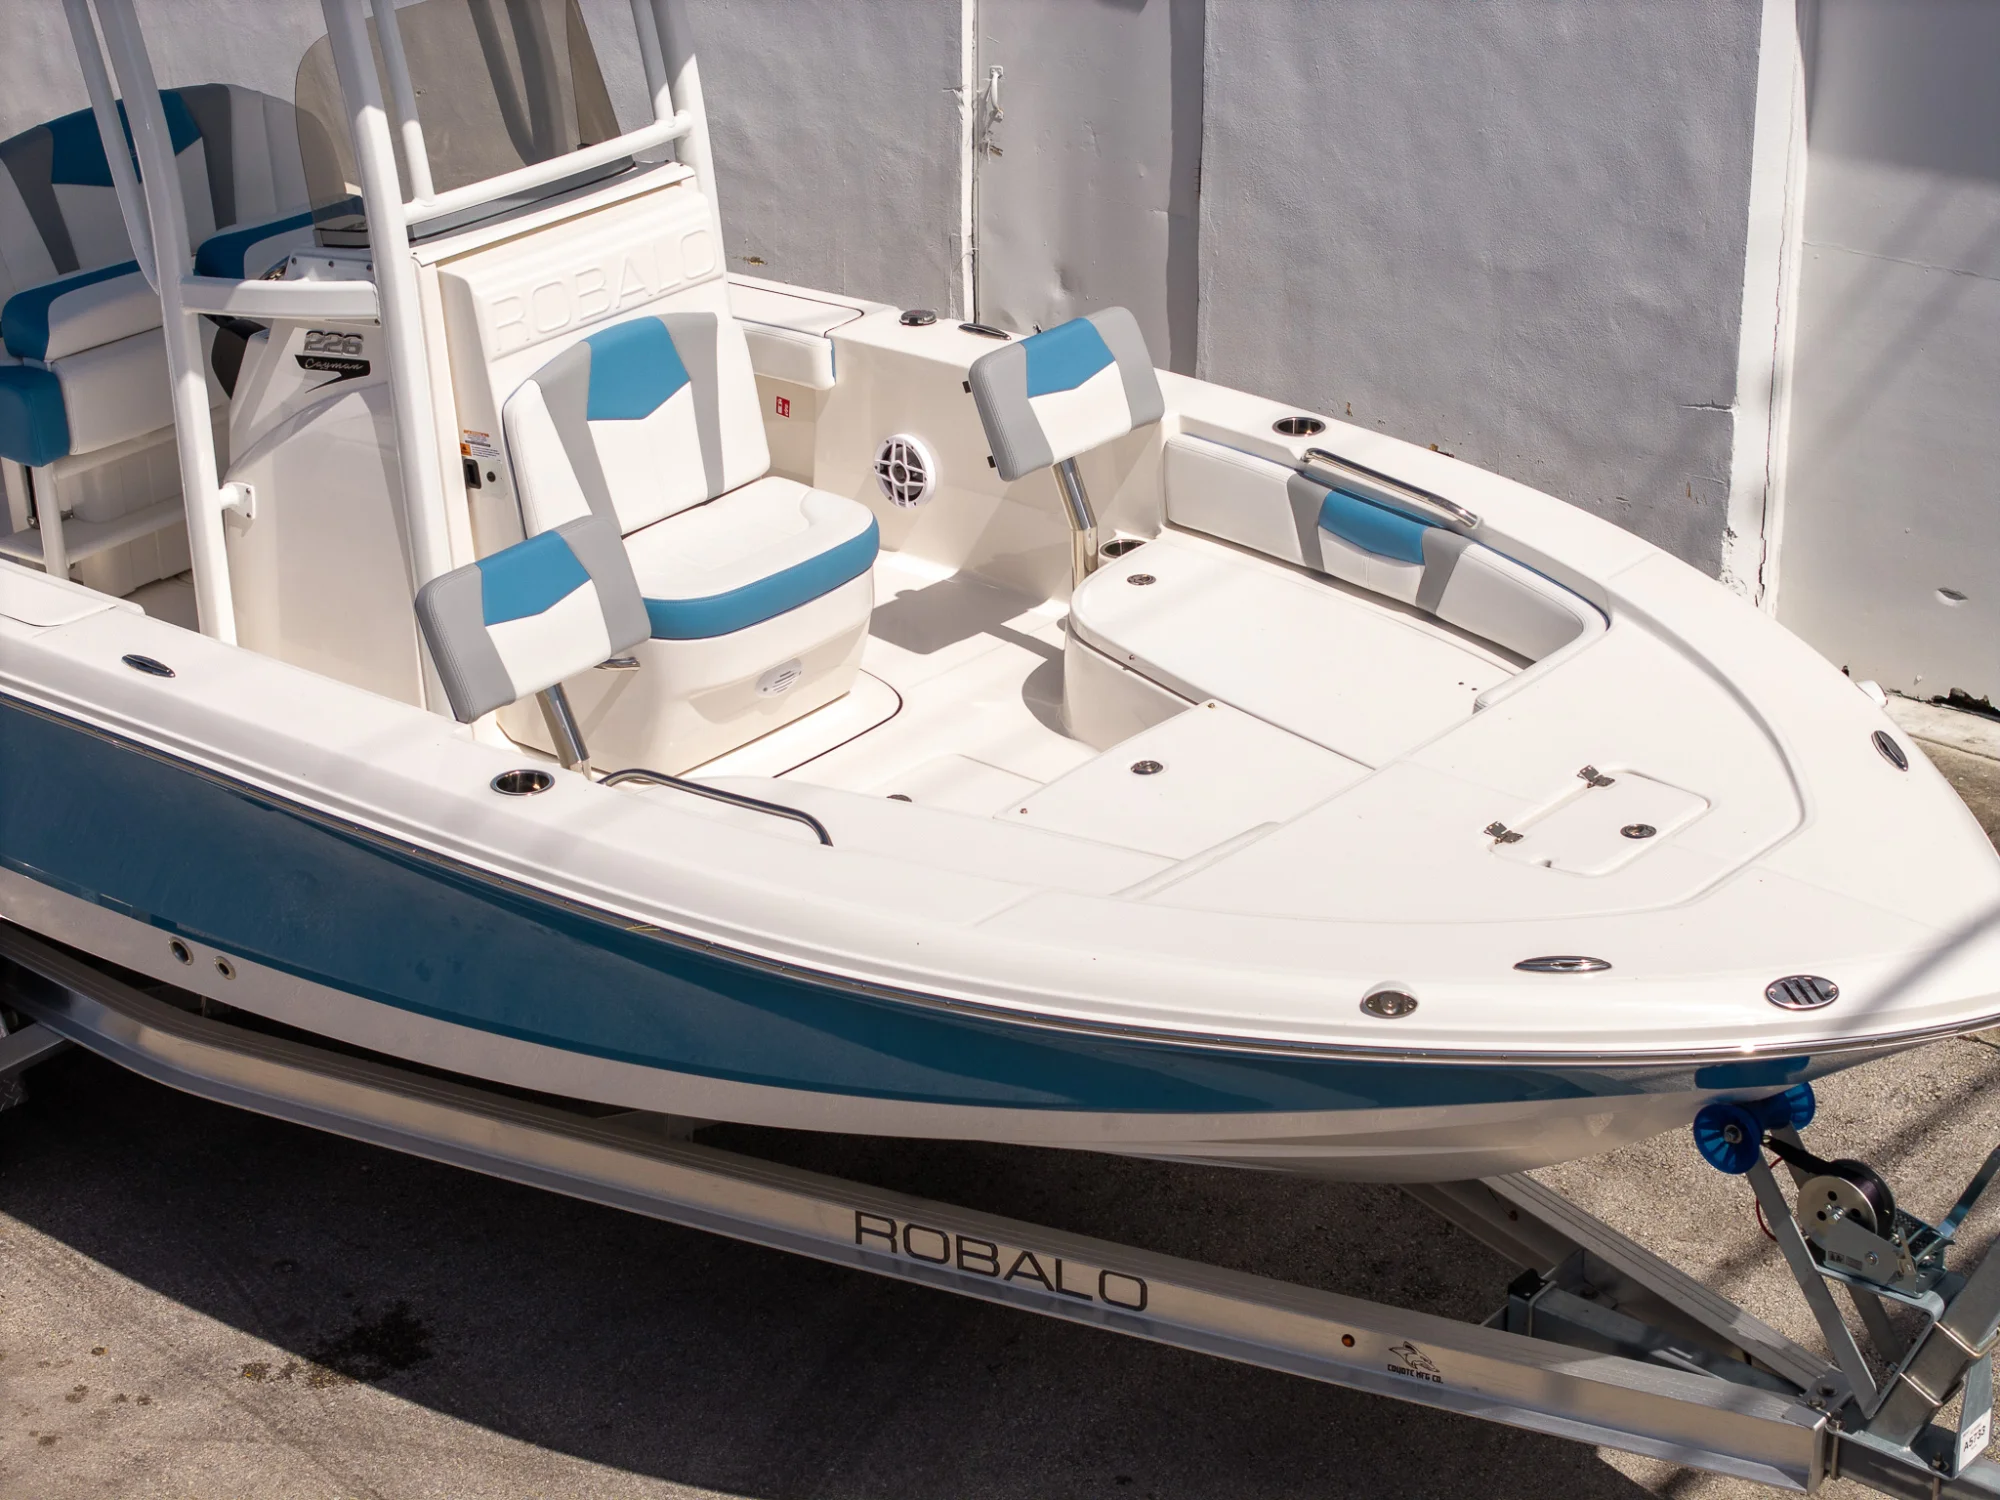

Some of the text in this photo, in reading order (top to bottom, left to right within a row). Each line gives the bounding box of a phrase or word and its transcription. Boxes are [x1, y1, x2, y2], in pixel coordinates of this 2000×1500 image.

[490, 229, 717, 351] ROBALO
[304, 330, 363, 356] 226
[305, 358, 363, 370] Cayman
[855, 1210, 1148, 1312] ROBALO
[1387, 1364, 1415, 1377] COYOTE
